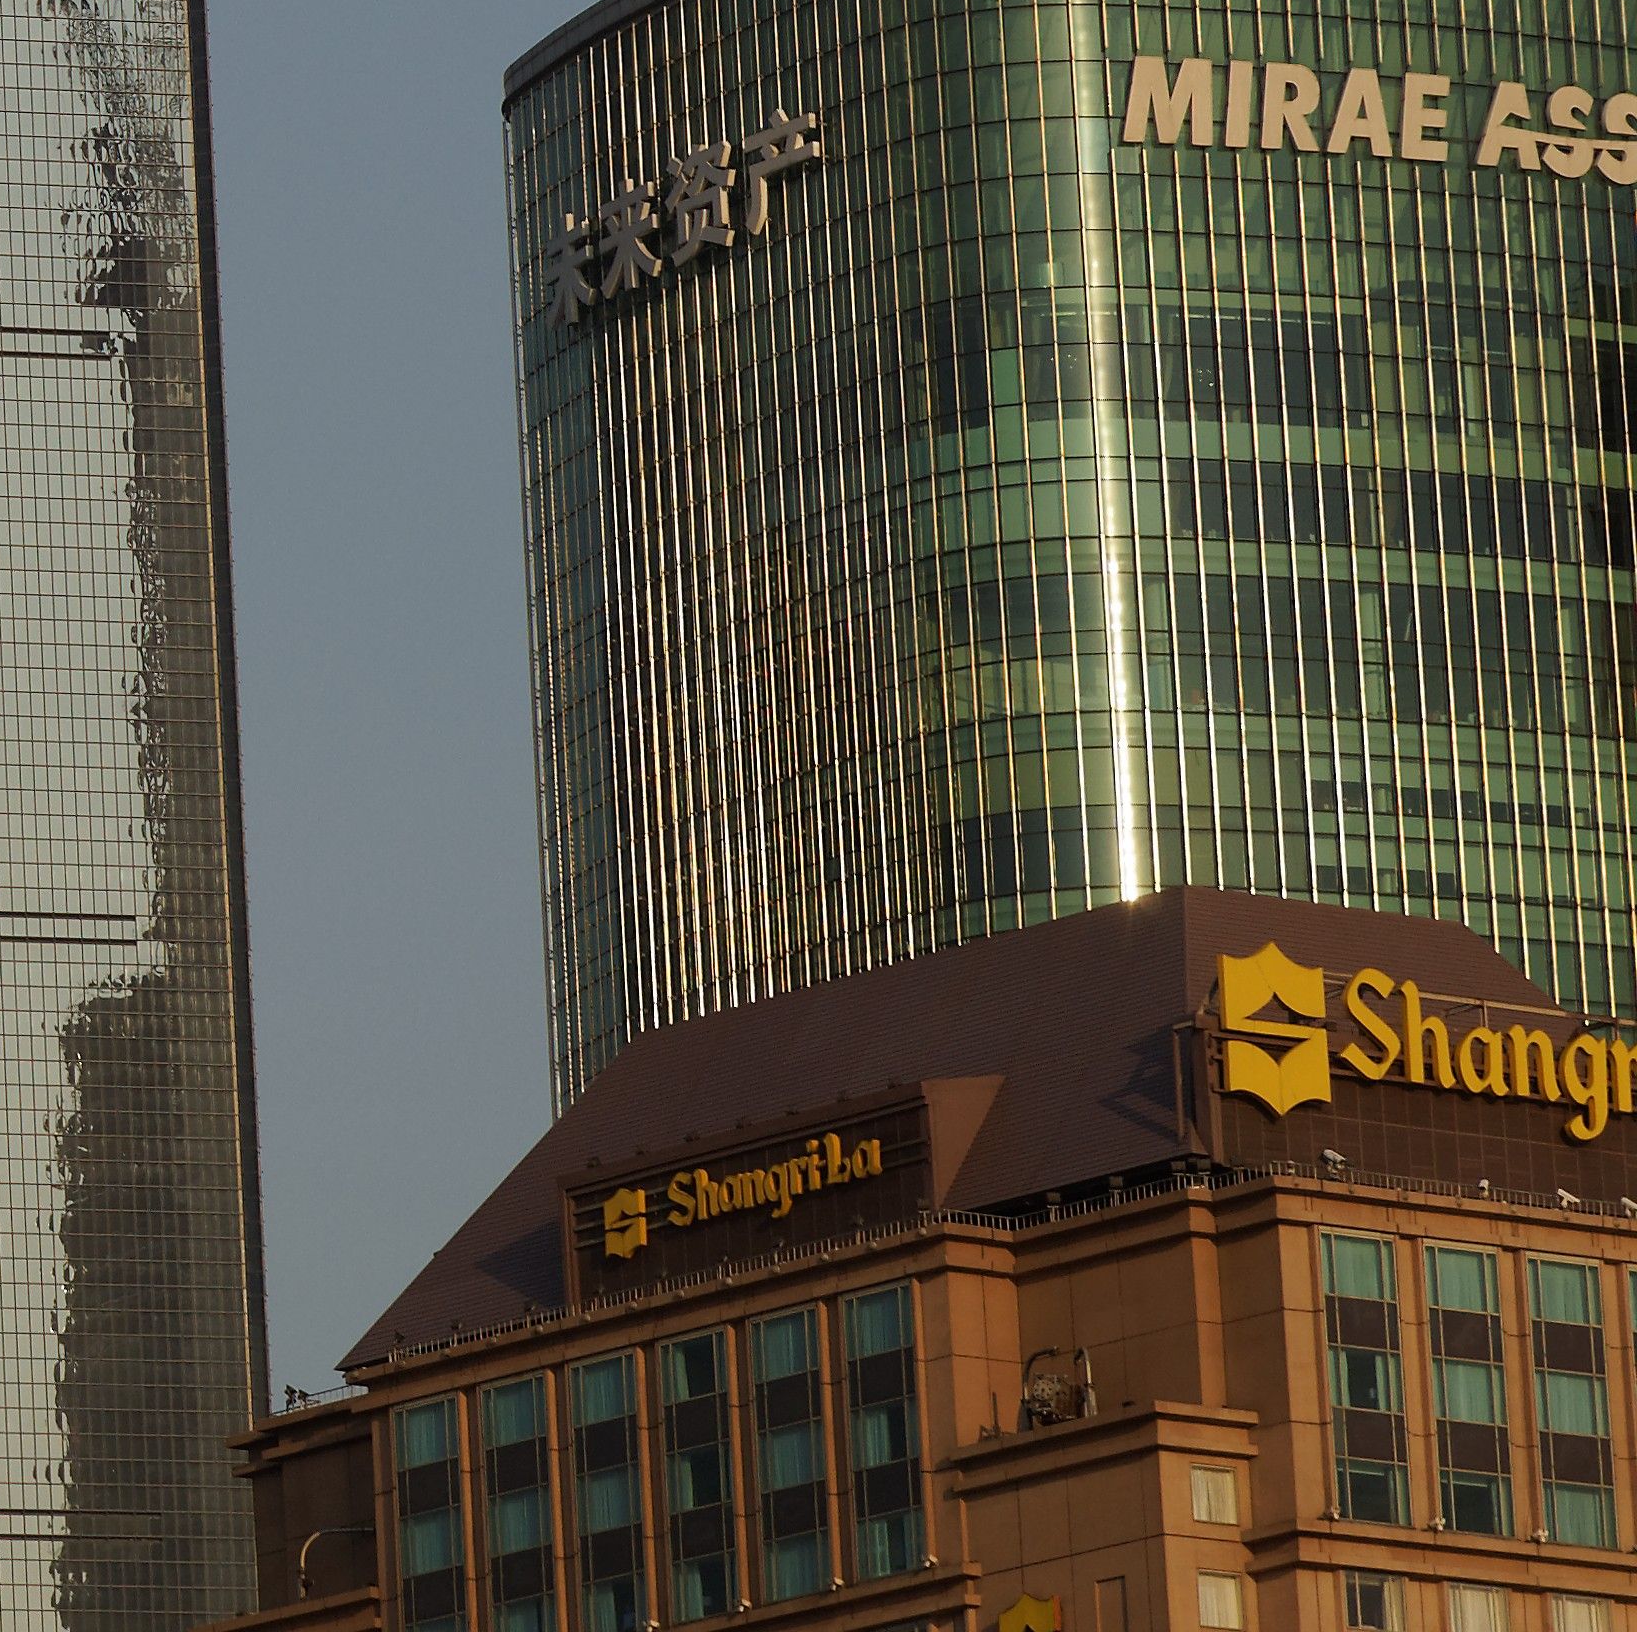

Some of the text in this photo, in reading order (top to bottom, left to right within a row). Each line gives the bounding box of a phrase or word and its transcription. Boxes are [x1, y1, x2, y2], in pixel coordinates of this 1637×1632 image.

[1124, 55, 1451, 162] MIRAE
[542, 108, 821, 328] 未来资产
[667, 1132, 883, 1227] Shangri-La
